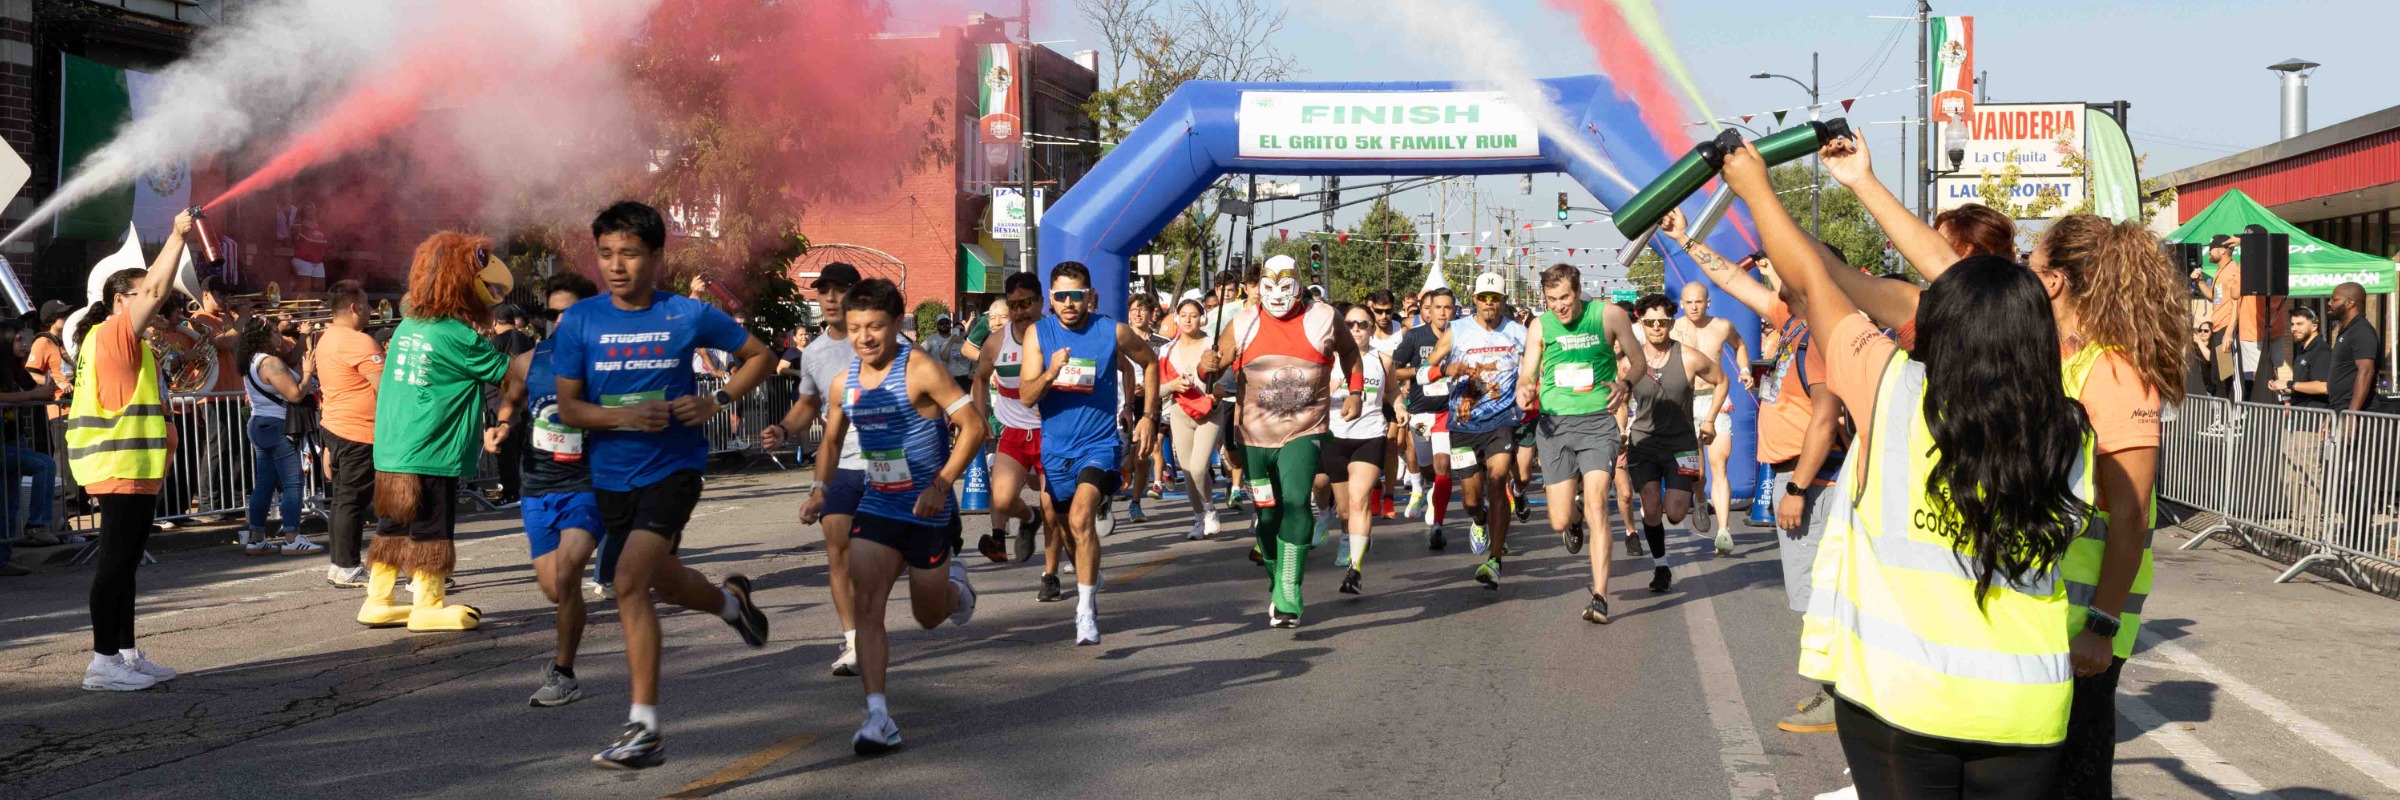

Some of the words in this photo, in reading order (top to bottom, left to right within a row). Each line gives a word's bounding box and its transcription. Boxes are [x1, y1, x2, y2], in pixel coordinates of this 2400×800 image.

[1301, 105, 1480, 124] FINISH
[1969, 110, 2076, 141] VANDERIA
[1259, 134, 1282, 149] EL
[1289, 134, 1348, 150] GRITO
[1355, 134, 1383, 150] 5K
[1390, 134, 1469, 150] FAMILY
[1476, 134, 1517, 149] RUN
[1974, 152, 1989, 163] La
[1993, 151, 2047, 165] Chquita
[1950, 183, 2071, 198] LAUROMAT
[599, 331, 671, 344] STUDENTS
[594, 361, 622, 371] RUN
[624, 359, 680, 370] CHICAGO
[1065, 366, 1082, 375] 554
[546, 432, 565, 443] 392
[873, 462, 891, 472] 510
